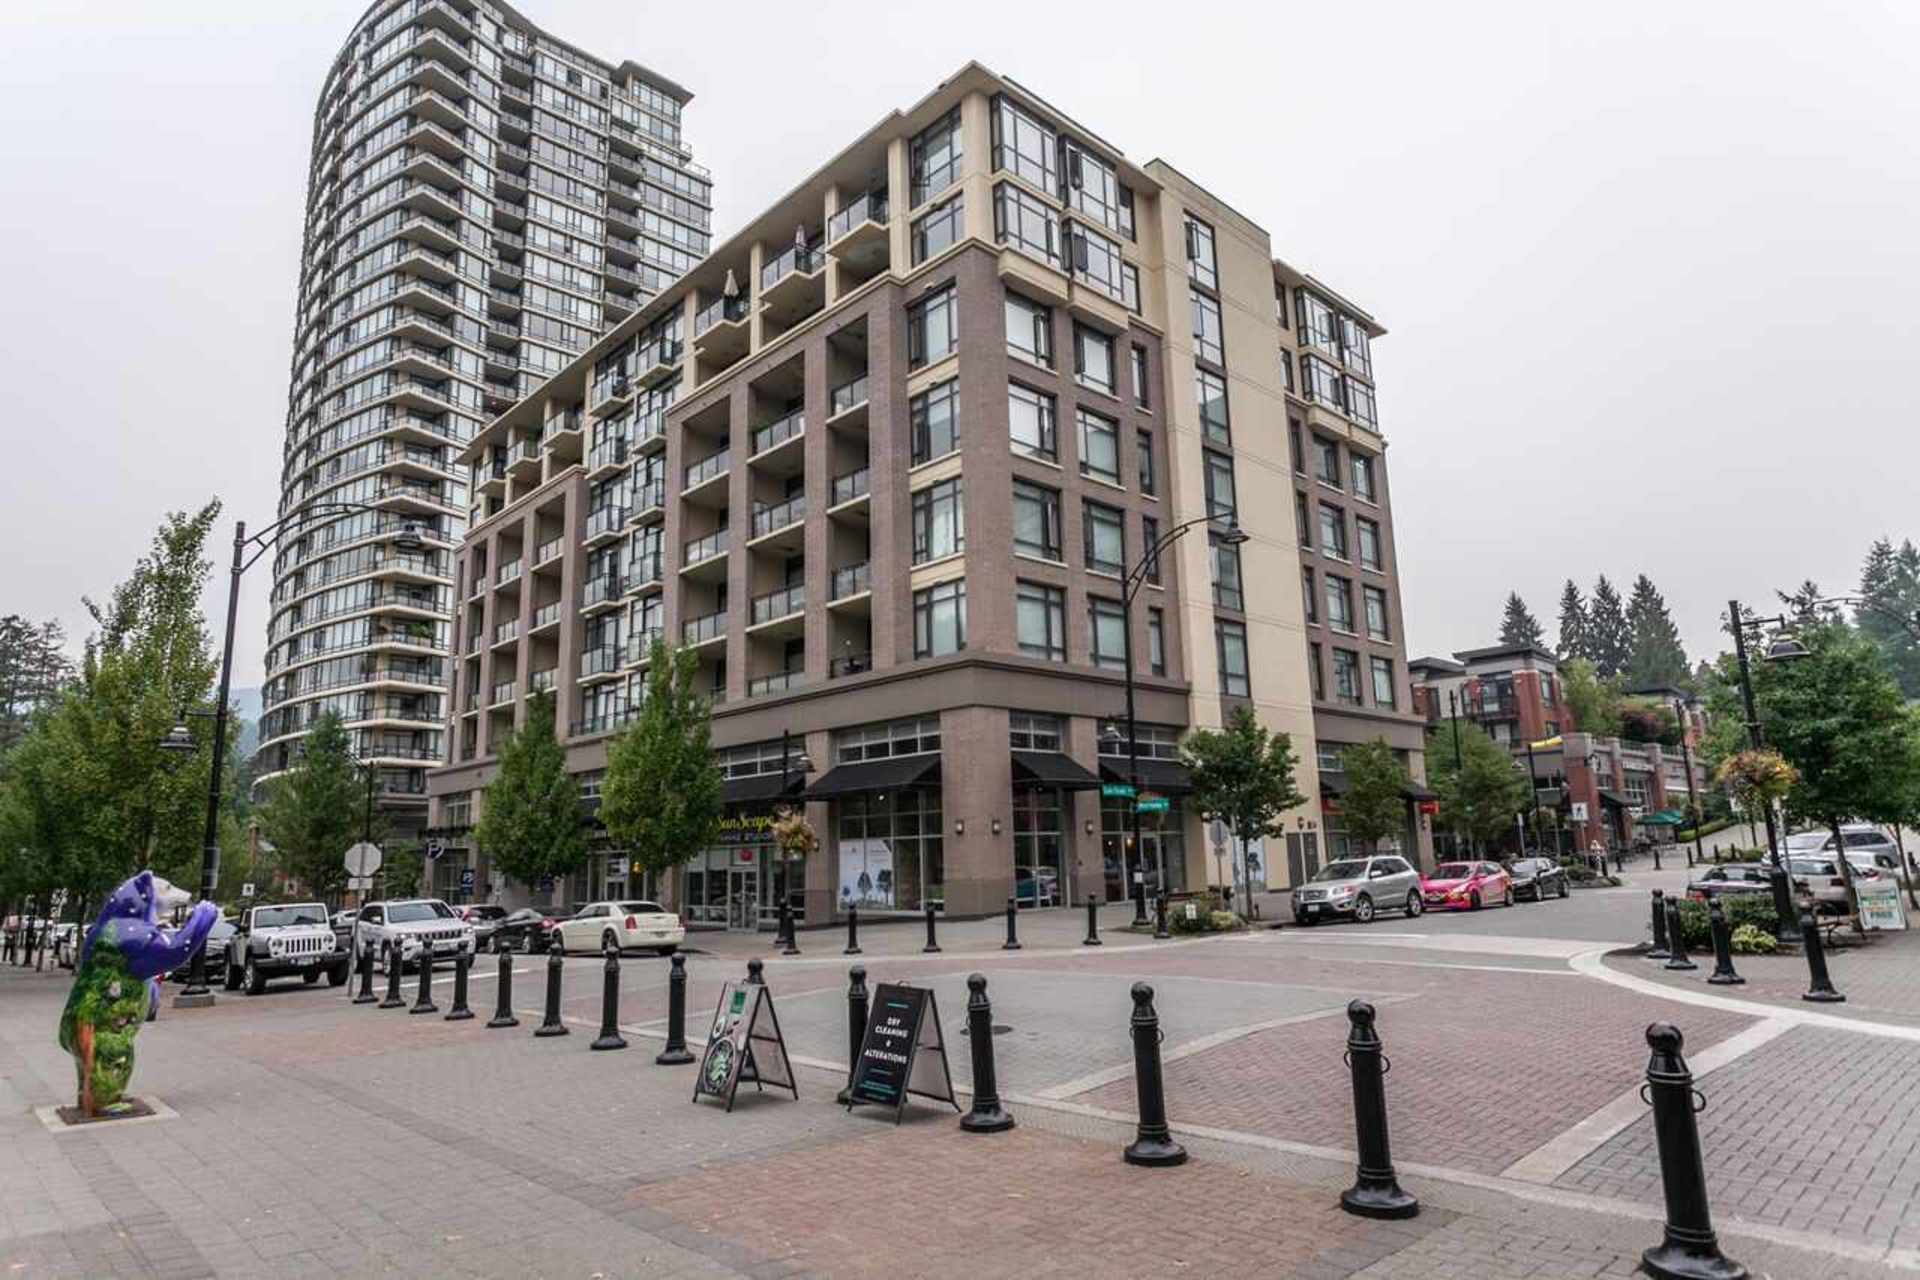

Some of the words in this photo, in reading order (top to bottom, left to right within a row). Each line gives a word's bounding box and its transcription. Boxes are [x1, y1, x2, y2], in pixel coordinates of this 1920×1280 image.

[887, 1017, 901, 1026] DRY
[875, 1025, 909, 1038] CLEANING
[864, 1048, 907, 1064] ALTERATIONS
